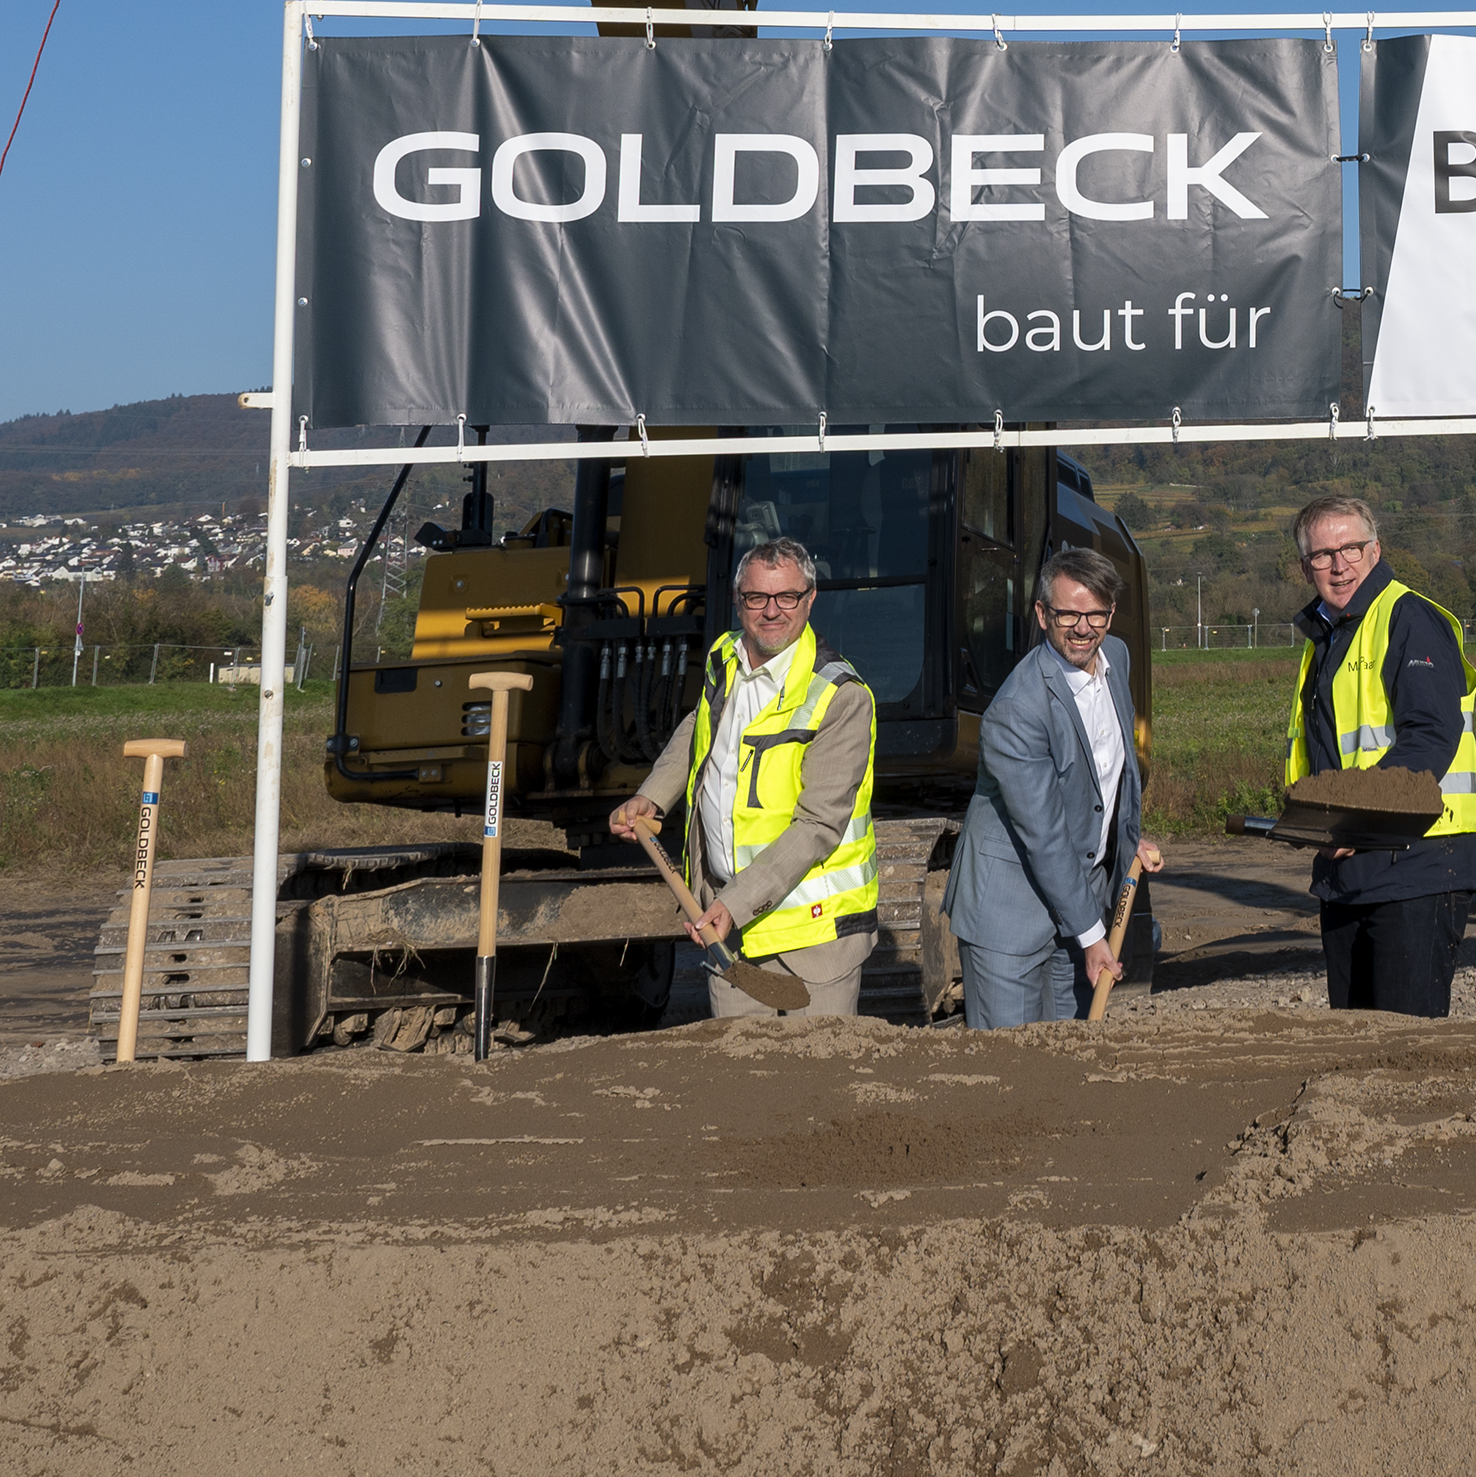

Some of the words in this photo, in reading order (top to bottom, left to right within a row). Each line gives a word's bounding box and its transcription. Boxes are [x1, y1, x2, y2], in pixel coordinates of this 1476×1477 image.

[373, 130, 1270, 224] GOLDBECK
[977, 295, 1145, 352] baut
[1168, 292, 1270, 349] für
[488, 763, 501, 825] GOLDBECK
[135, 807, 151, 889] GOLDBECK
[1113, 884, 1131, 929] GOLDBECK
